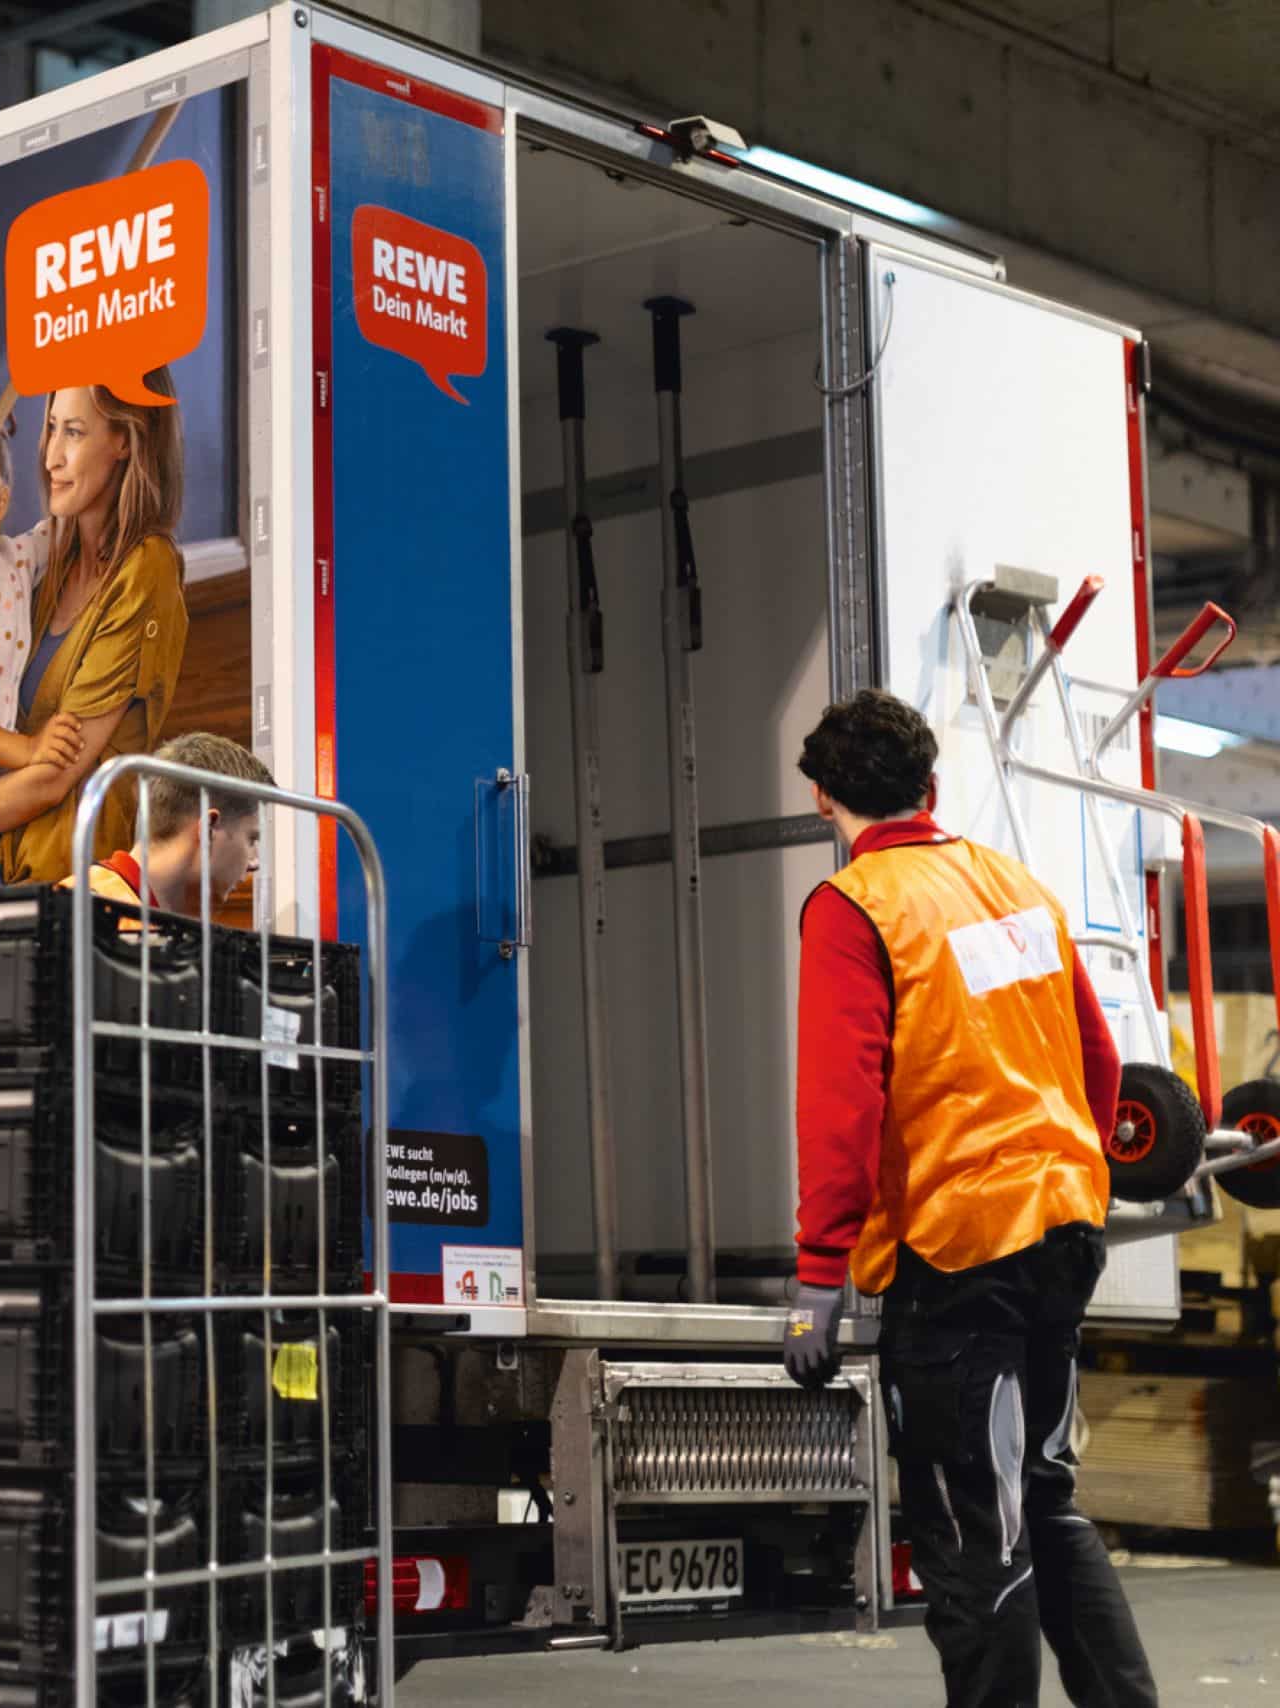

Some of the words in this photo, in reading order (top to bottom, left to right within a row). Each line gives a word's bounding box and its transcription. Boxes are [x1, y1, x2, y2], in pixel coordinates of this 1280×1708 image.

[35, 203, 176, 299] REWE
[372, 237, 468, 304] REWE
[34, 308, 89, 348] Dein
[96, 277, 176, 330] Markt
[372, 285, 412, 320] Dein
[416, 301, 469, 340] Markt
[385, 1143, 406, 1160] EWE
[407, 1146, 434, 1161] sucht
[386, 1165, 428, 1184] Kollegen
[386, 1186, 478, 1214] ewe.de/jobs
[669, 1545, 738, 1593] 9678
